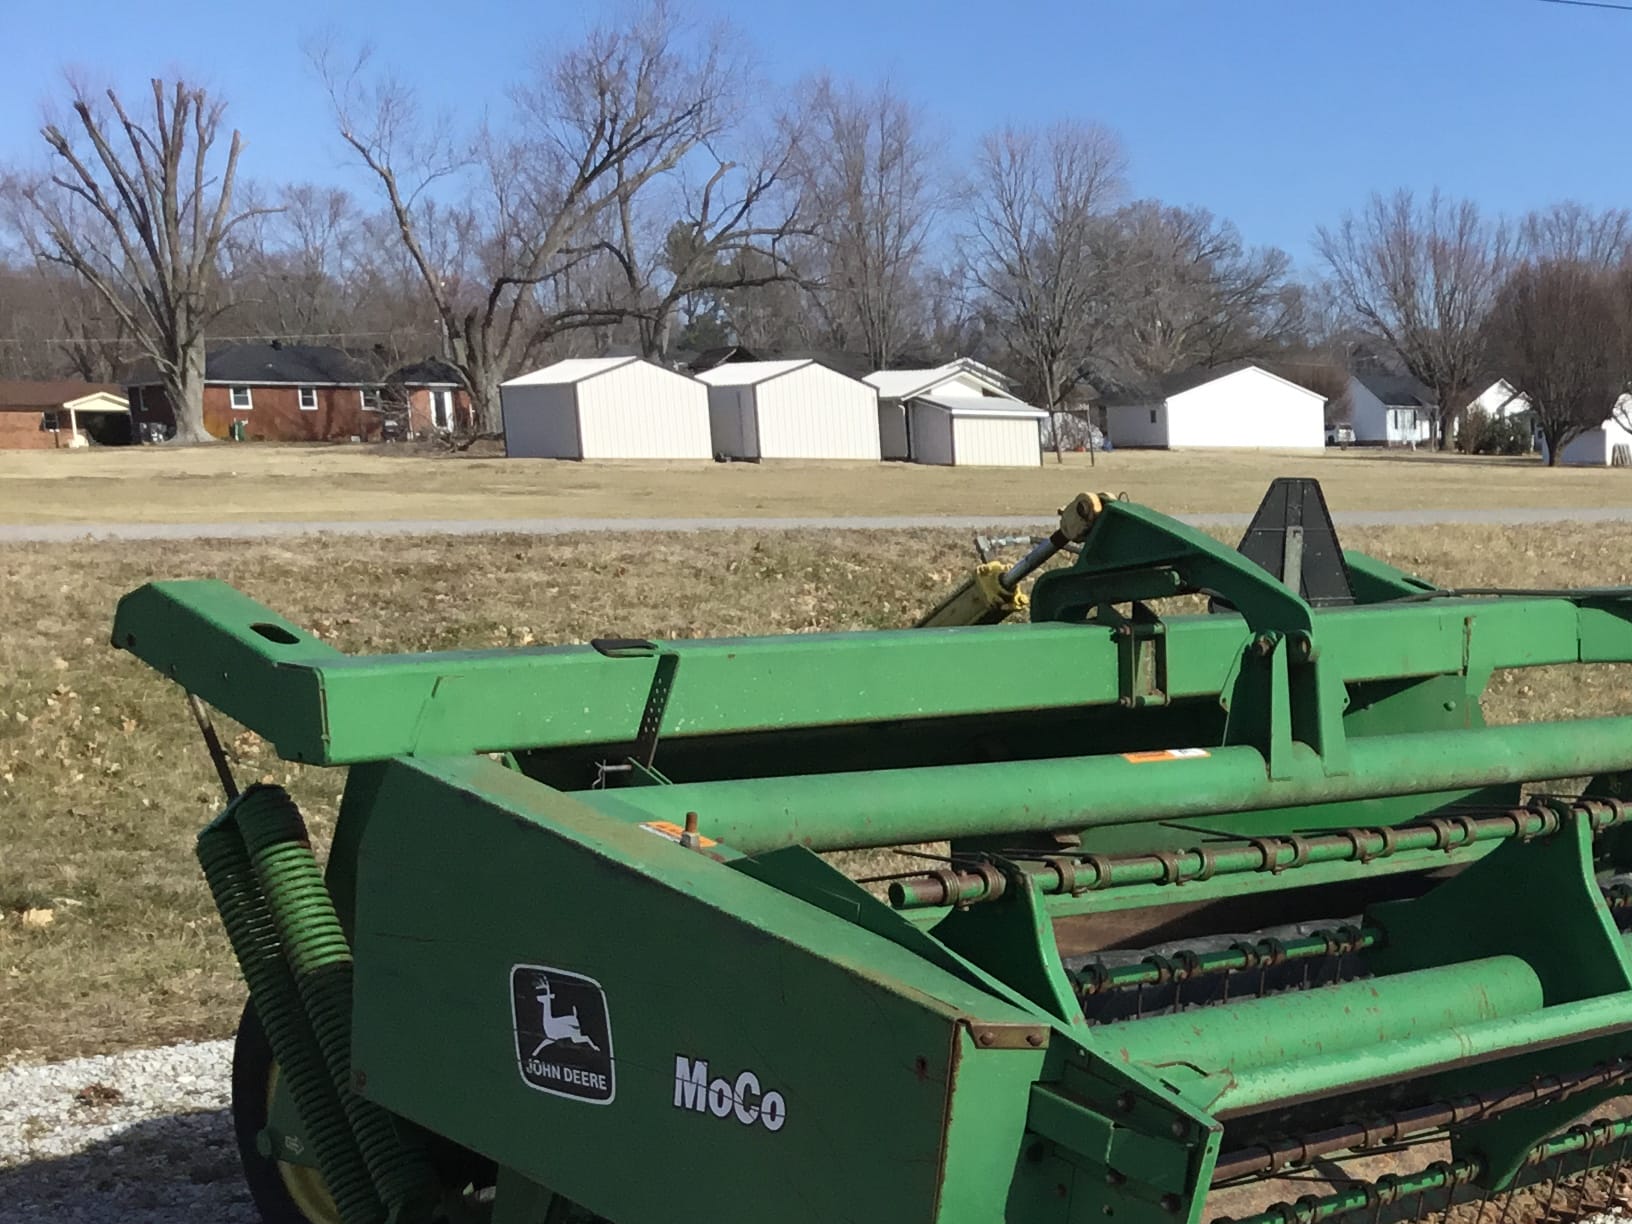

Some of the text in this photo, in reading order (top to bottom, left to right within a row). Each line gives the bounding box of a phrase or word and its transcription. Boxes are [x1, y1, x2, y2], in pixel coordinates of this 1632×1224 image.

[525, 1058, 608, 1091] JOHN DEERE
[674, 1055, 786, 1132] MoCo
